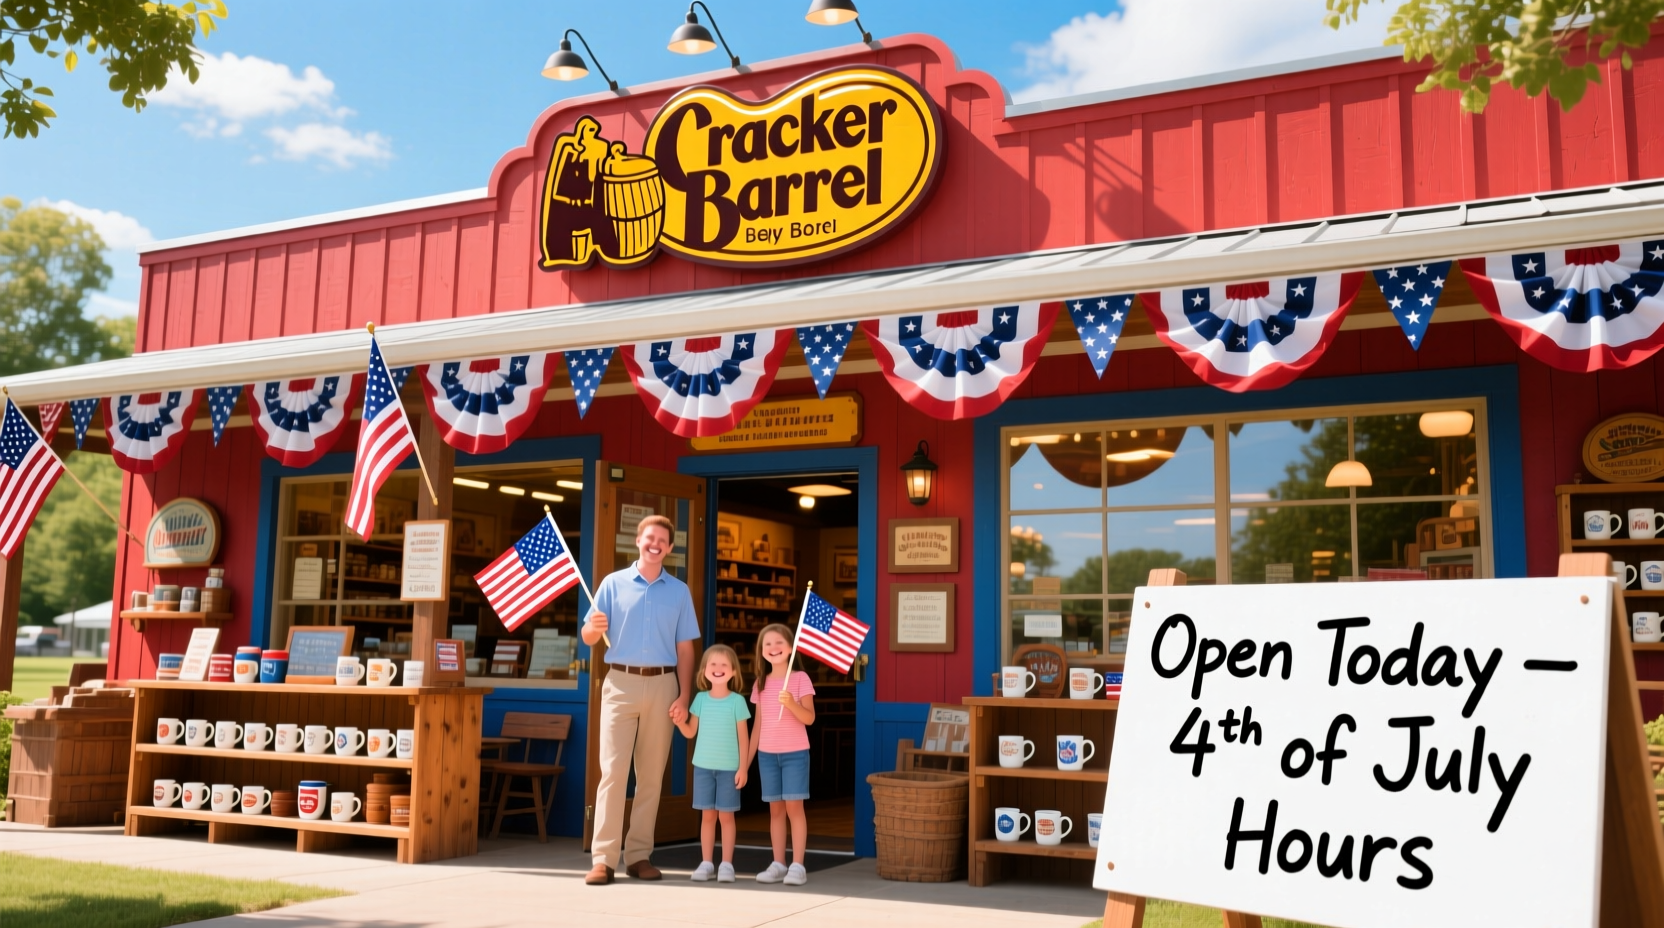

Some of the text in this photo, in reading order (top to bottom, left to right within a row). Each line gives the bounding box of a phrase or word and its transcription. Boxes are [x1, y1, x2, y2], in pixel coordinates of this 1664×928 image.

[654, 94, 898, 193] Cracker
[683, 147, 883, 250] Barrel
[790, 218, 837, 238] Borel
[1150, 613, 1293, 700] Open
[1317, 616, 1503, 719] Today
[1169, 706, 1532, 833] 4th of July
[1224, 796, 1434, 890] Hours
